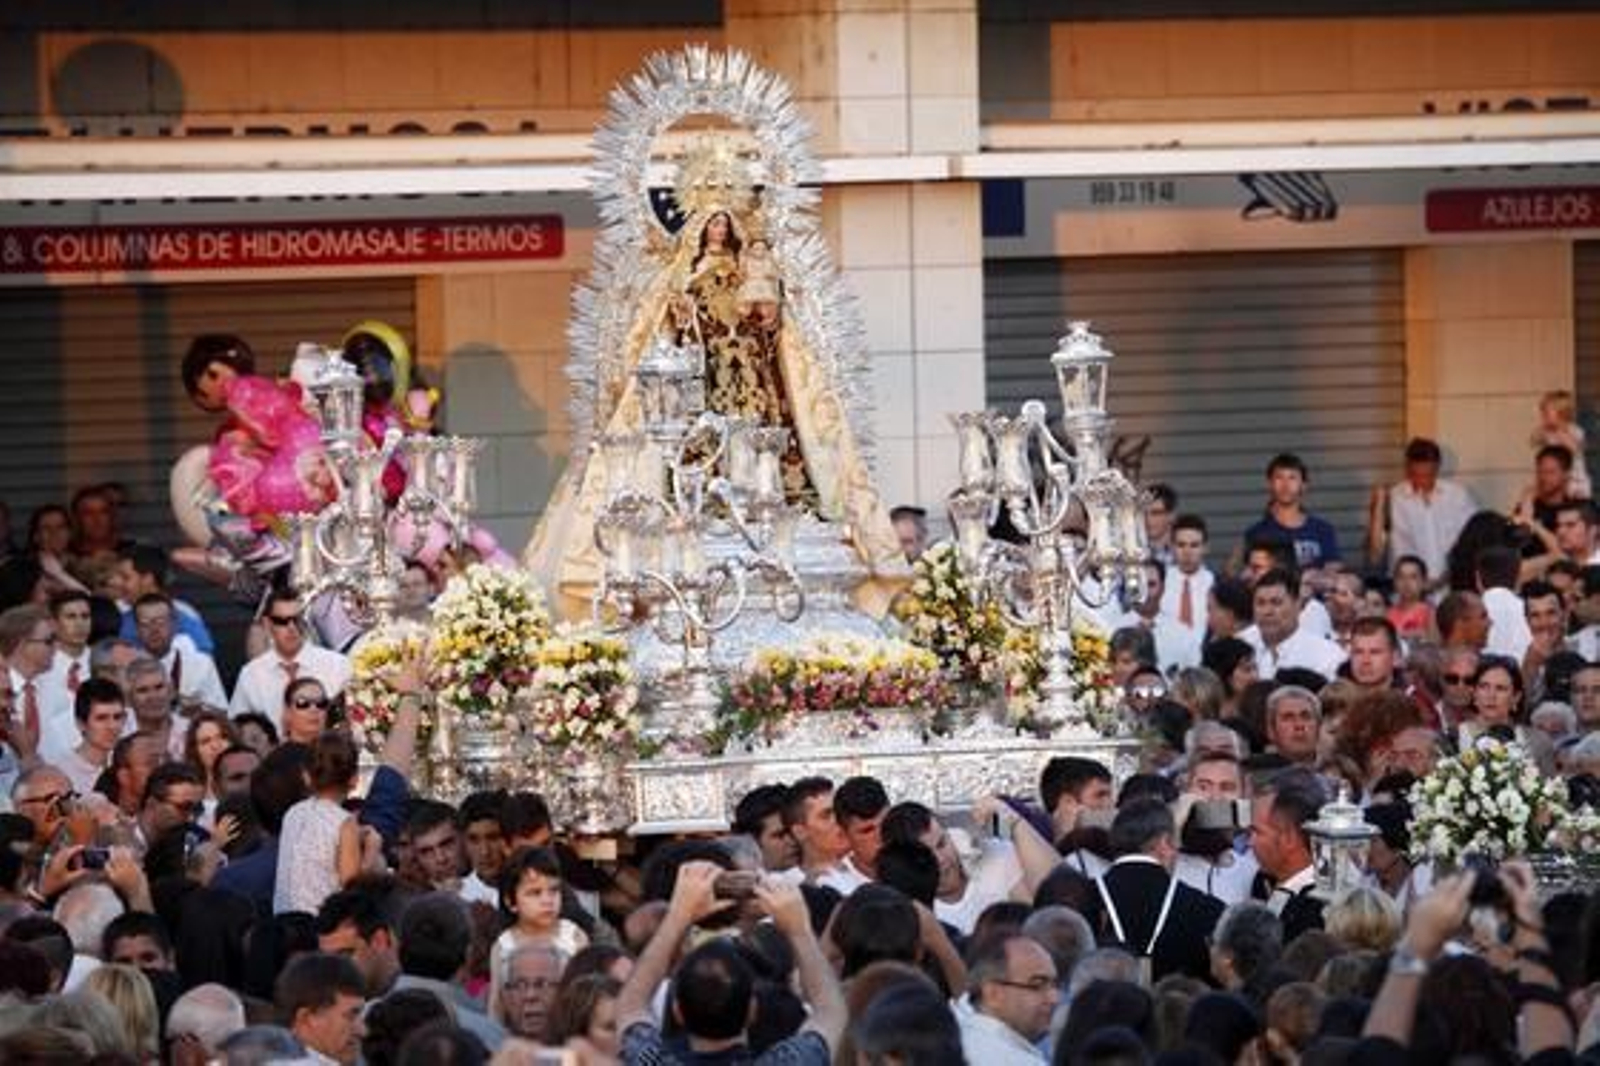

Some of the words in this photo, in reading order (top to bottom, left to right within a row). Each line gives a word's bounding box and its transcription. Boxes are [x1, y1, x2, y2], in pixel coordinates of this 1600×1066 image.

[1484, 194, 1591, 222] AZULEJOS
[33, 231, 190, 264] COLUMNAS
[198, 231, 232, 260] DE
[240, 227, 426, 259] HIDROMASAJE
[433, 223, 545, 252] -TERMOS
